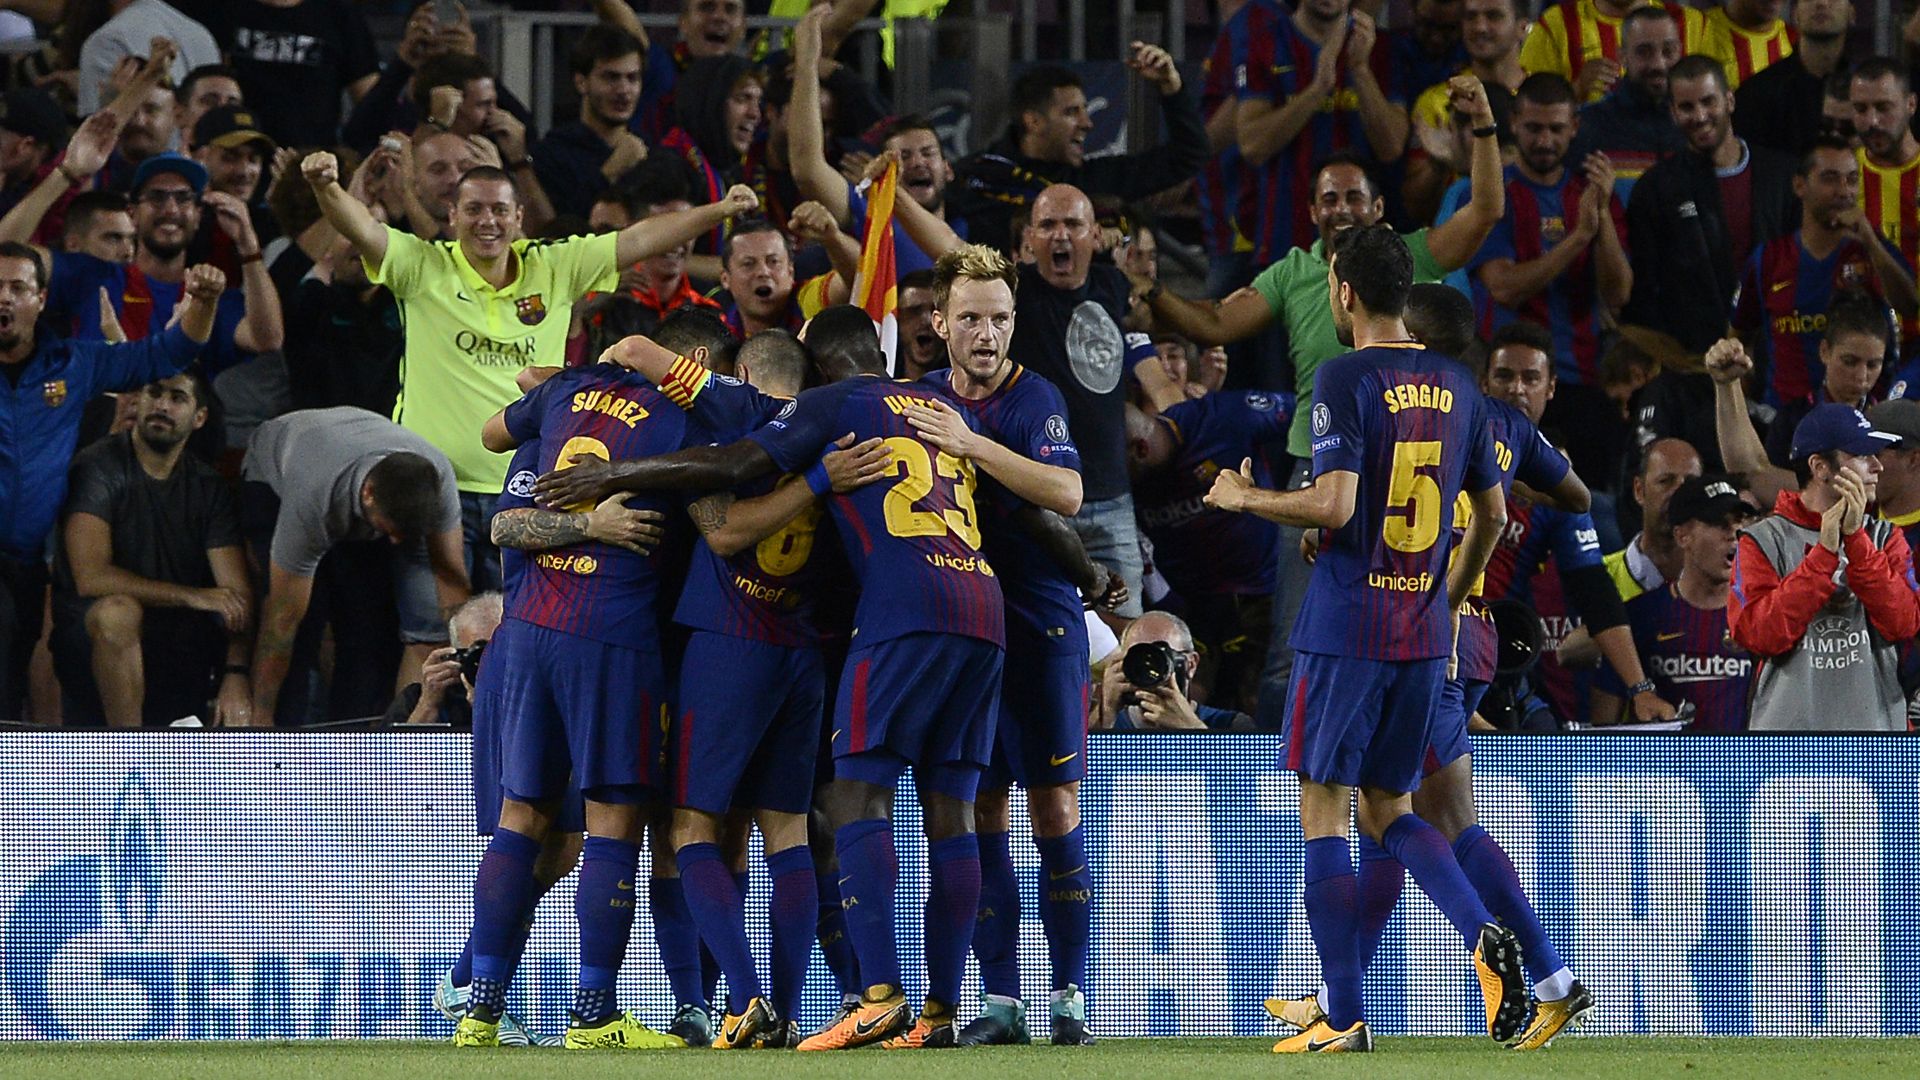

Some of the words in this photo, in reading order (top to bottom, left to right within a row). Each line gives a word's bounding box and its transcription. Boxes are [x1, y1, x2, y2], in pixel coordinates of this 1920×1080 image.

[455, 330, 536, 356] QATAR
[571, 390, 651, 430] SUÁREZ
[1384, 383, 1454, 415] SERGIO
[882, 436, 982, 552] 23
[1382, 440, 1443, 553] 5
[925, 553, 977, 573] unicef
[1368, 571, 1428, 593] unicef
